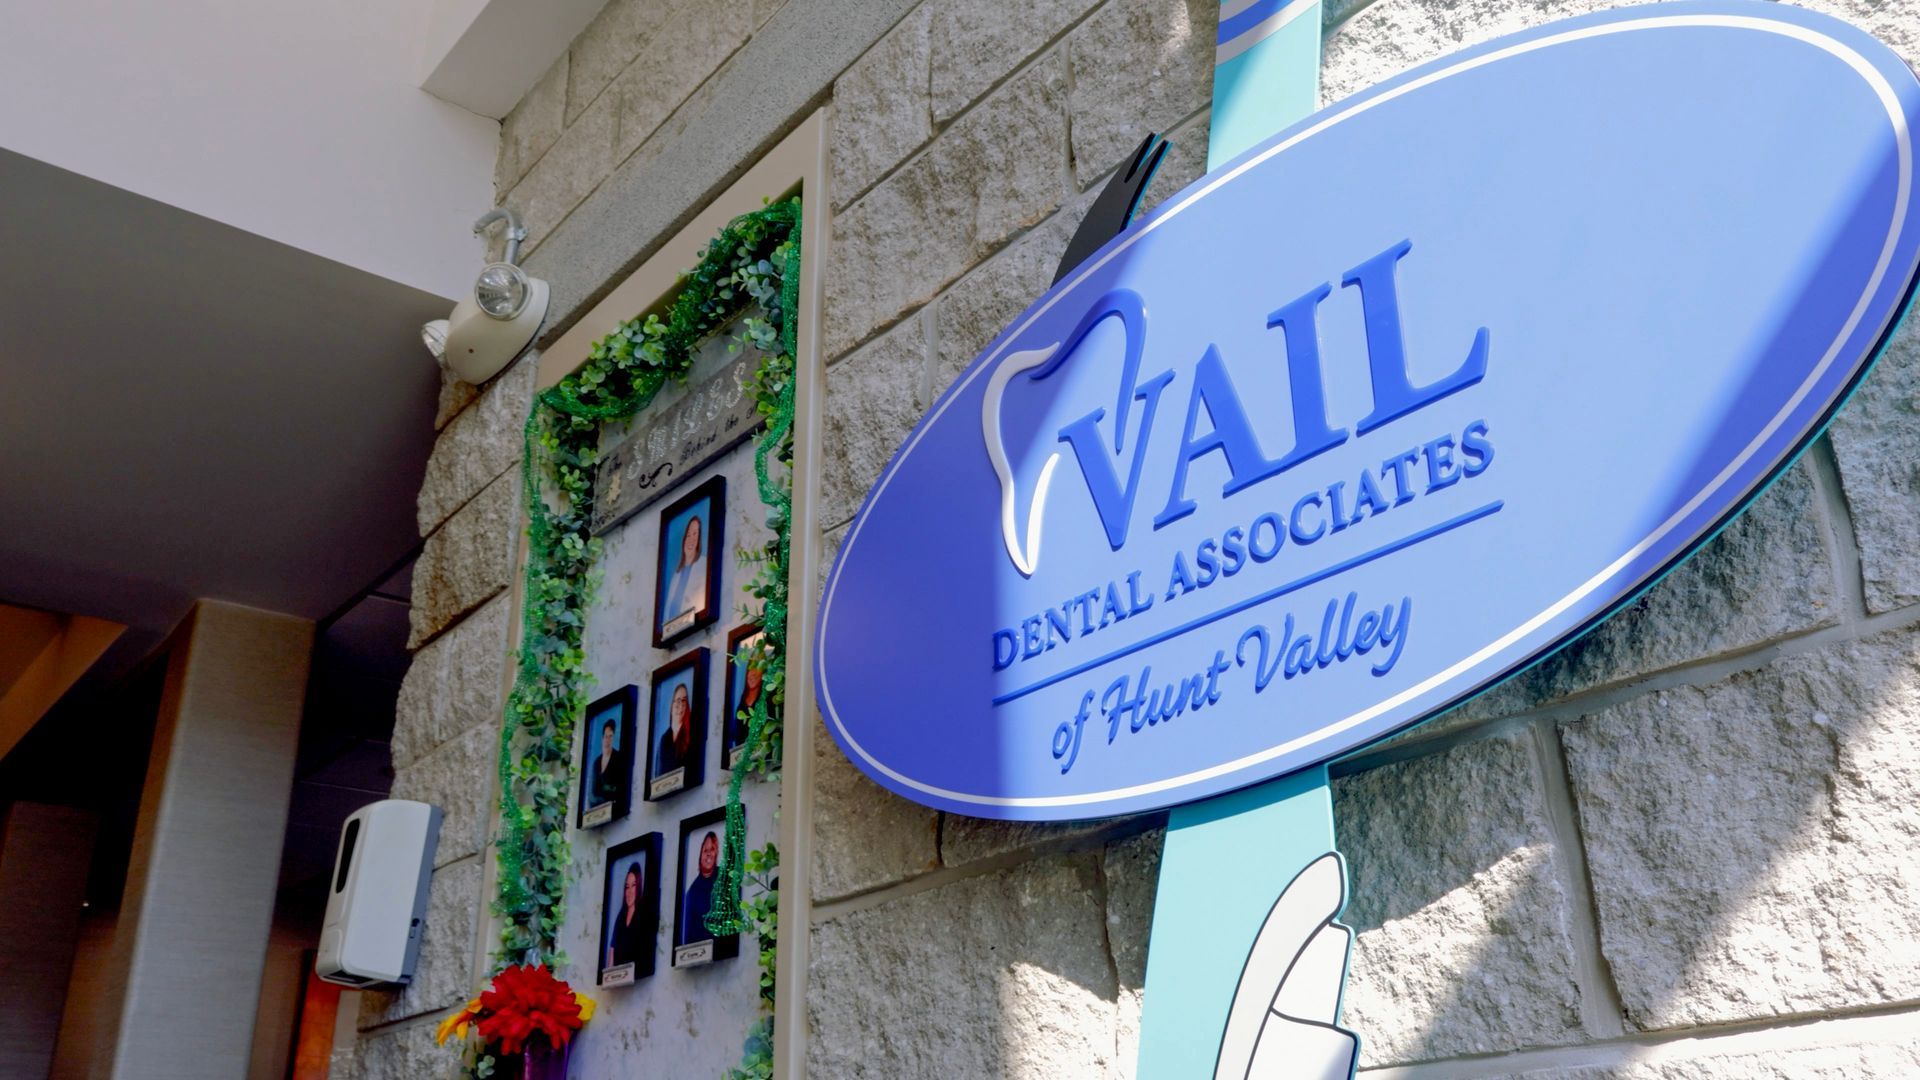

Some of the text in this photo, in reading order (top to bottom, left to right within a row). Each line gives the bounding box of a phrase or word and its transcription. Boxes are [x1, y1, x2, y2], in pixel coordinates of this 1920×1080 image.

[626, 361, 747, 480] SMILES
[1058, 238, 1490, 550] VAIL
[992, 417, 1495, 673] DENTAL ASSOCIATES
[1051, 590, 1413, 774] of Hunt Valley
